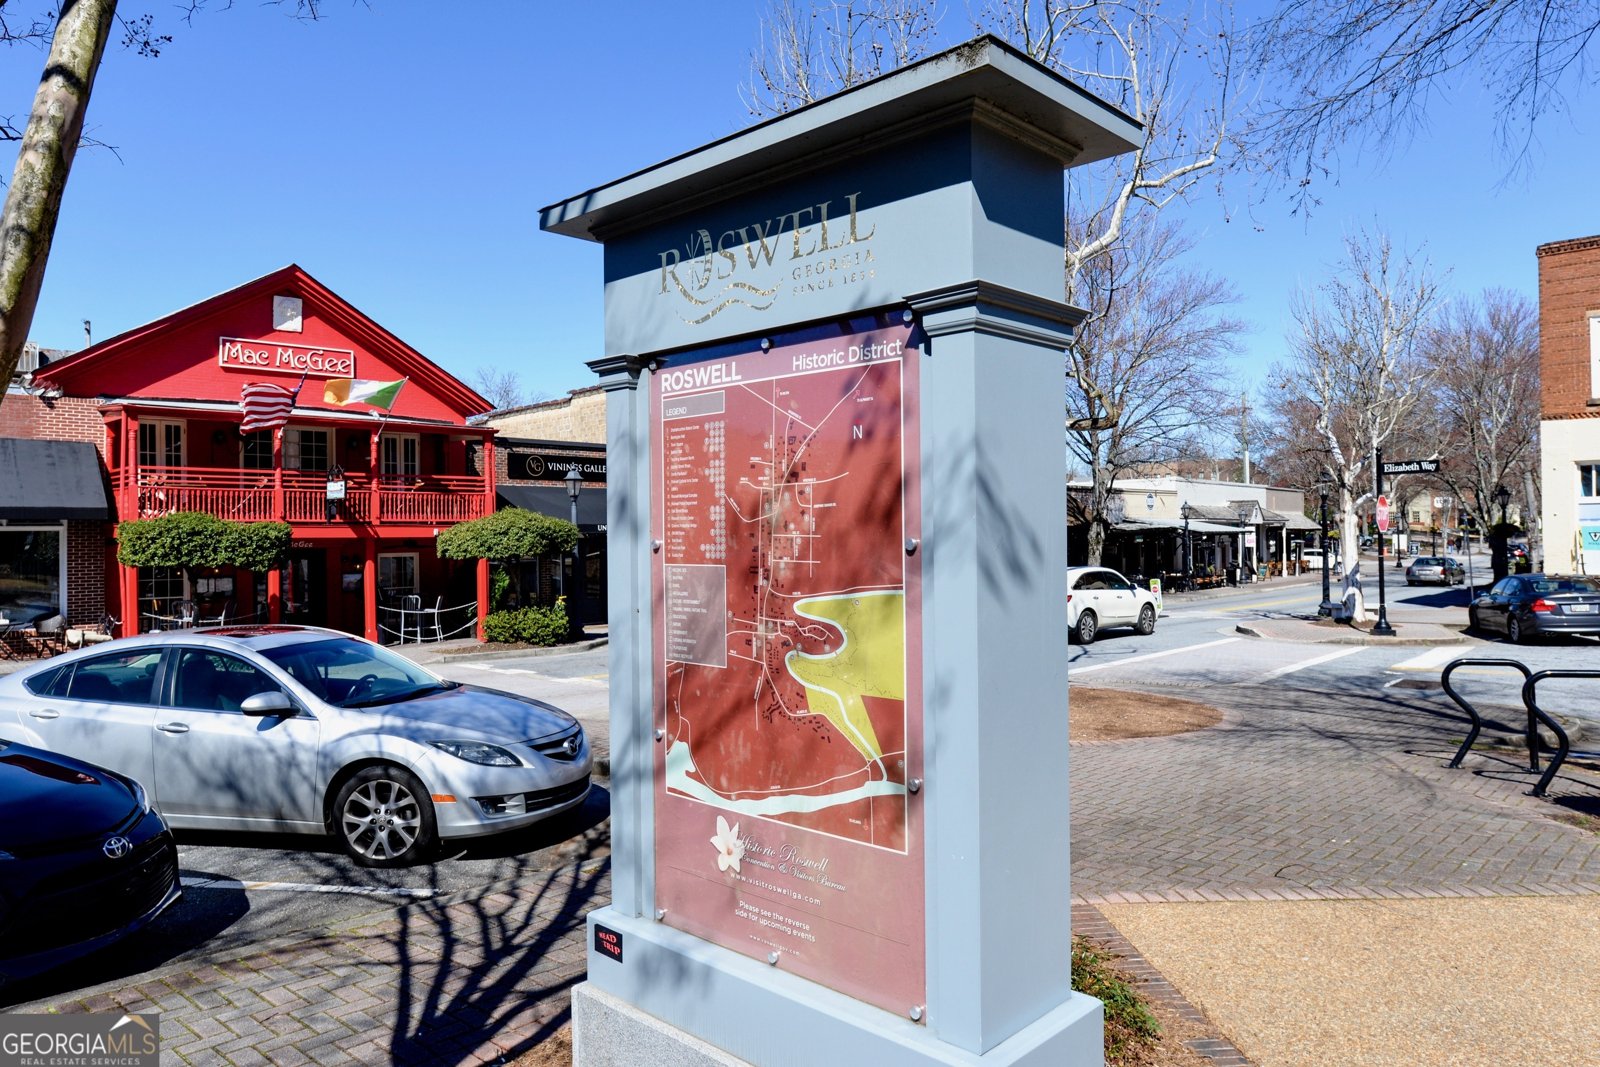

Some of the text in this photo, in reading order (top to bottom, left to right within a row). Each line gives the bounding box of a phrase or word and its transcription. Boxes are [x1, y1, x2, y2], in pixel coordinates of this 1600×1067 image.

[658, 191, 876, 295] ROSWELL
[792, 249, 876, 281] GEORGIA
[793, 278, 834, 297] SINCE
[223, 342, 350, 373] Mac McGee
[792, 338, 903, 372] Historic District
[661, 361, 742, 393] ROSWELL
[665, 406, 688, 417] LEGEND
[853, 424, 863, 440] N
[583, 464, 607, 473] GALLE
[1384, 461, 1437, 473] Elizabeth Way
[739, 831, 829, 872] Historic Roswell
[730, 872, 821, 906] www.visitroswellga.com
[735, 909, 816, 943] side for upcoming events
[739, 900, 810, 931] Please see the reverse
[598, 932, 617, 944] HEAD
[602, 941, 621, 955] TRIP
